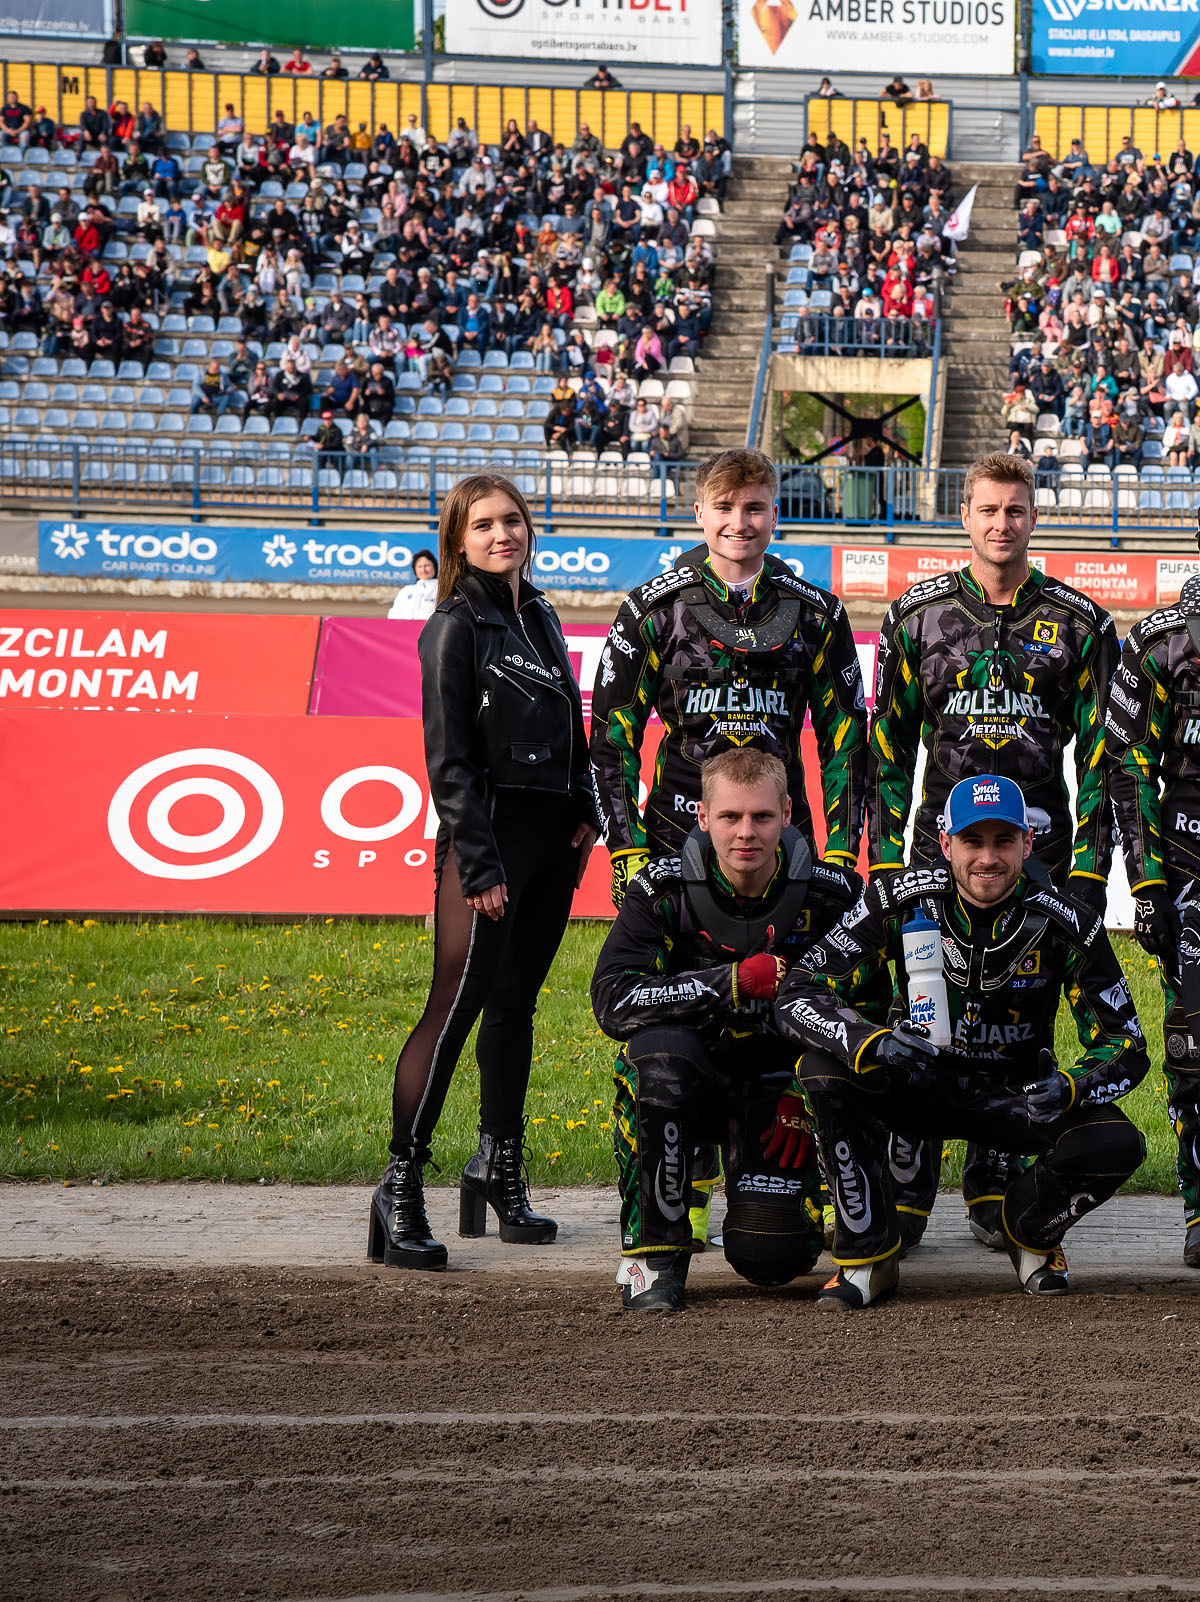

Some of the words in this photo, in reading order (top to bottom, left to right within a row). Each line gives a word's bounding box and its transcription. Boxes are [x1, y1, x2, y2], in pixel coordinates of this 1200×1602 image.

[542, 11, 622, 23] SPORTA
[808, 0, 894, 24] AMBER
[903, 1, 1005, 26] STUDIOS
[826, 30, 989, 44] WWW.AMBER-STUDIOS.COM
[62, 76, 79, 95] M
[95, 529, 218, 561] trodo
[302, 539, 413, 568] trodo
[102, 560, 128, 571] CAR
[129, 561, 170, 573] PARTS
[171, 563, 216, 575] ONLINE
[535, 545, 611, 573] odo
[845, 553, 886, 566] PUFAS
[1075, 562, 1128, 575] IZCILAM
[1159, 562, 1200, 574] PUFAS
[308, 568, 331, 578] CAR
[333, 569, 369, 579] PARTS
[370, 570, 411, 581] ONLINE
[569, 575, 609, 586] ONLINE
[524, 661, 553, 680] OPTIBET
[685, 687, 790, 716] KOLEJARZ
[943, 689, 1050, 718] KOLEJARZ
[727, 713, 755, 721] RAWICZ
[704, 718, 777, 741] METALIKA
[959, 720, 1036, 742] METALIKA
[972, 779, 1000, 795] Smak
[973, 793, 1000, 804] MAK
[892, 868, 949, 892] ACDC
[1024, 890, 1081, 934] METALIKA
[1134, 920, 1152, 934] FOX
[613, 977, 721, 1013] METALIKA
[637, 992, 697, 1007] RECYCLING
[779, 997, 849, 1051] METALIKA
[791, 1009, 836, 1040] RECYCLING
[954, 1018, 1036, 1045] EJARZ
[664, 1121, 679, 1201] WIKO
[736, 1173, 803, 1189] ACDC
[835, 1140, 864, 1217] WIKO
